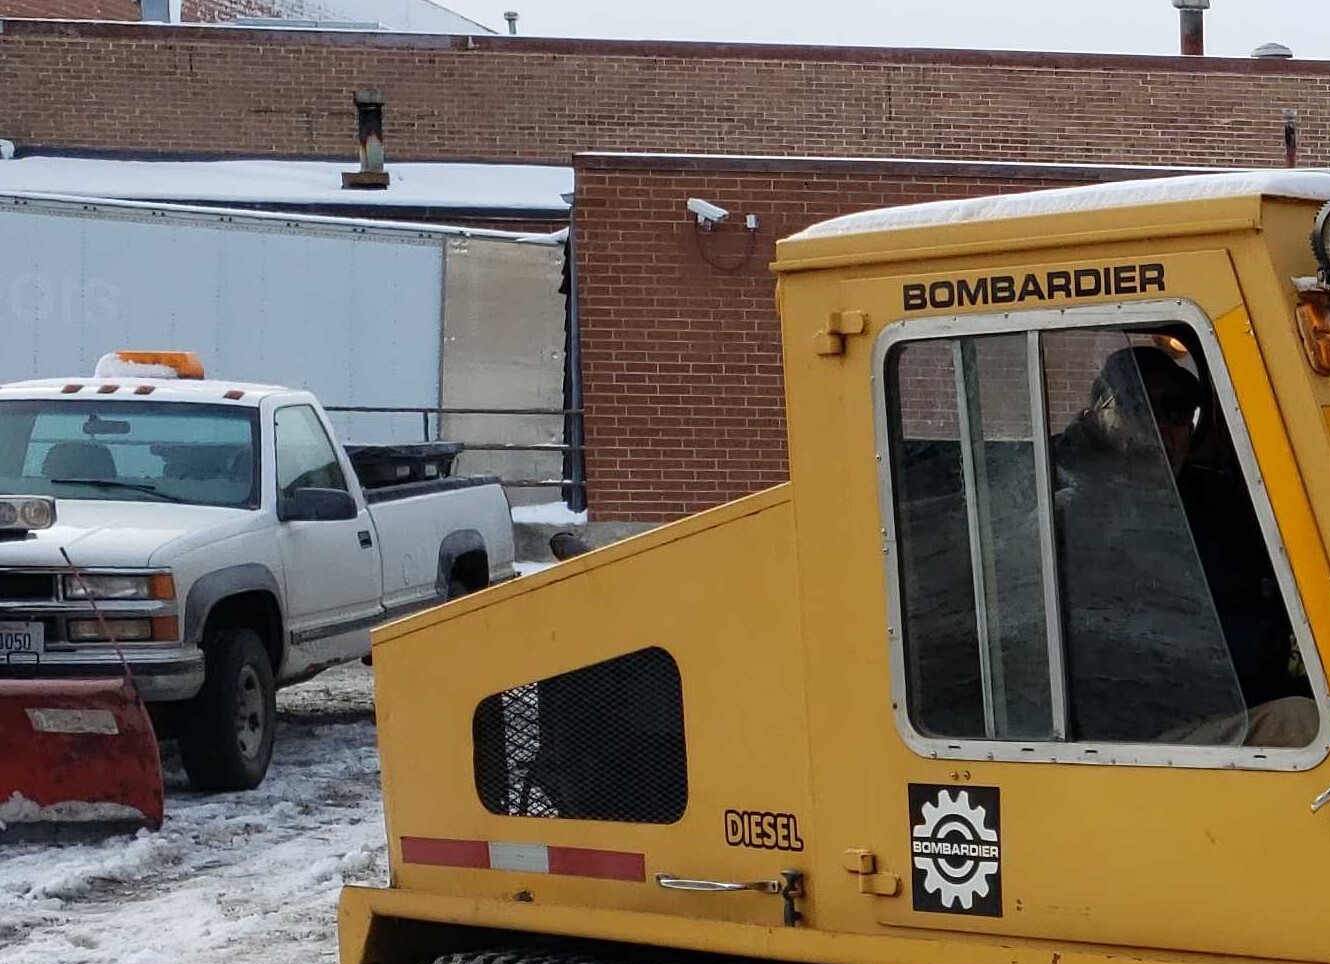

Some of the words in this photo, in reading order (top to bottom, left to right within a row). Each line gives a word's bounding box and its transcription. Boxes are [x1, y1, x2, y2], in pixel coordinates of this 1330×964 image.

[903, 263, 1165, 311] BOMBARDIER
[725, 810, 803, 851] DIESEL
[913, 840, 999, 858] BOMBARDIER
